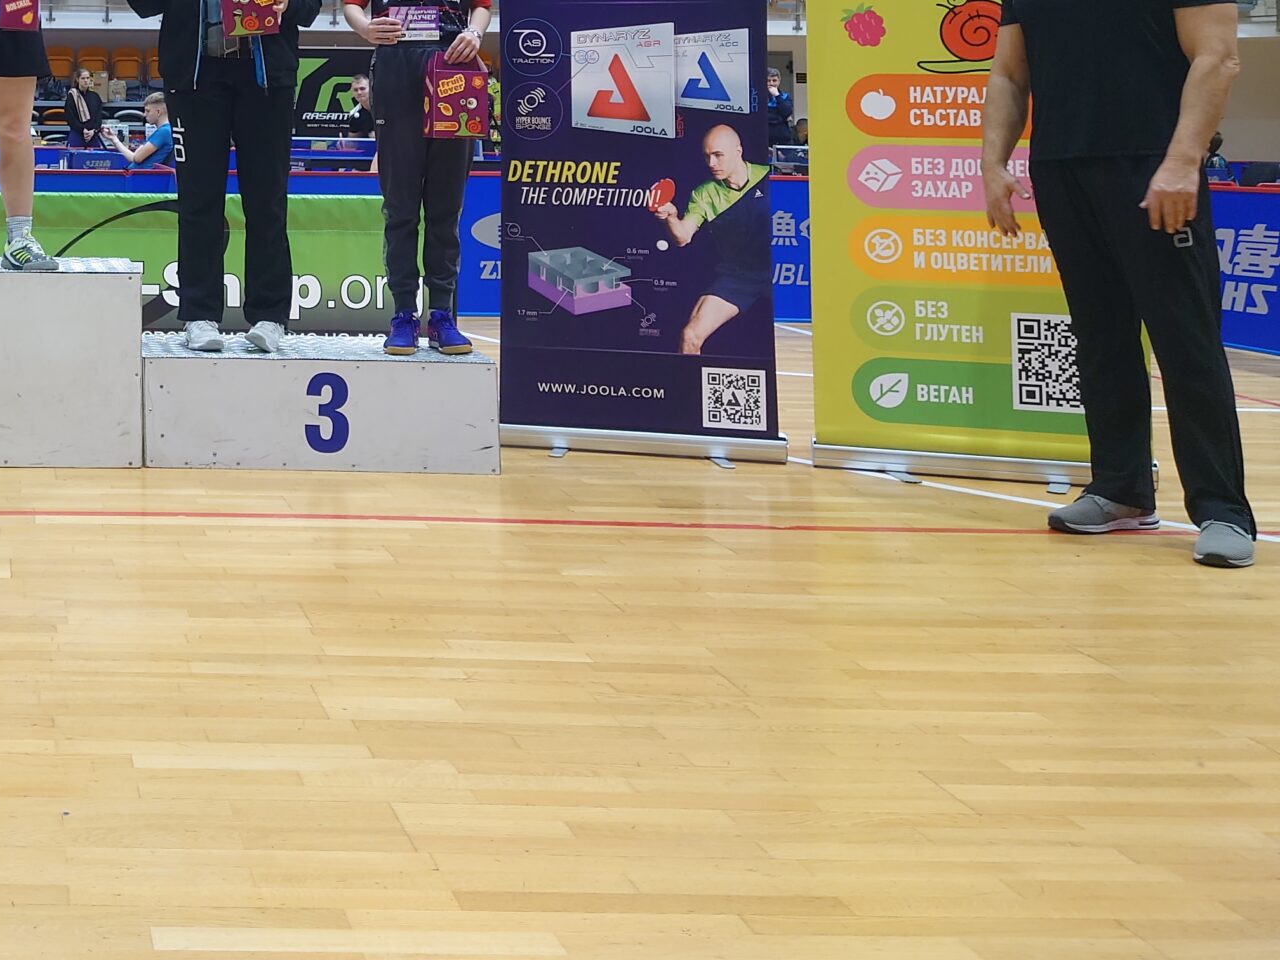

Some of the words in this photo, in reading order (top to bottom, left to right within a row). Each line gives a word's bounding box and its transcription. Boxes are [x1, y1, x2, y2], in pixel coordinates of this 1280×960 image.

[577, 30, 651, 44] DYNARYZ
[440, 84, 463, 95] lover
[441, 76, 463, 88] Fruit
[630, 126, 668, 136] JOOLA
[508, 160, 621, 184] DETHRONE
[911, 158, 945, 176] БЕЗ
[520, 187, 548, 205] THE
[551, 188, 661, 208] COMPETITION!
[911, 180, 973, 198] ЗАХАР
[913, 229, 949, 246] БЕЗ
[914, 252, 925, 268] И
[930, 252, 1052, 273] ОЦВЕТИТЕЛИ
[915, 300, 949, 318] БЕЗ
[915, 324, 984, 343] ГЛУТЕН
[538, 382, 665, 399] WWW.JOOLA.COM
[916, 384, 974, 404] ВЕГАН
[303, 371, 350, 453] 3
